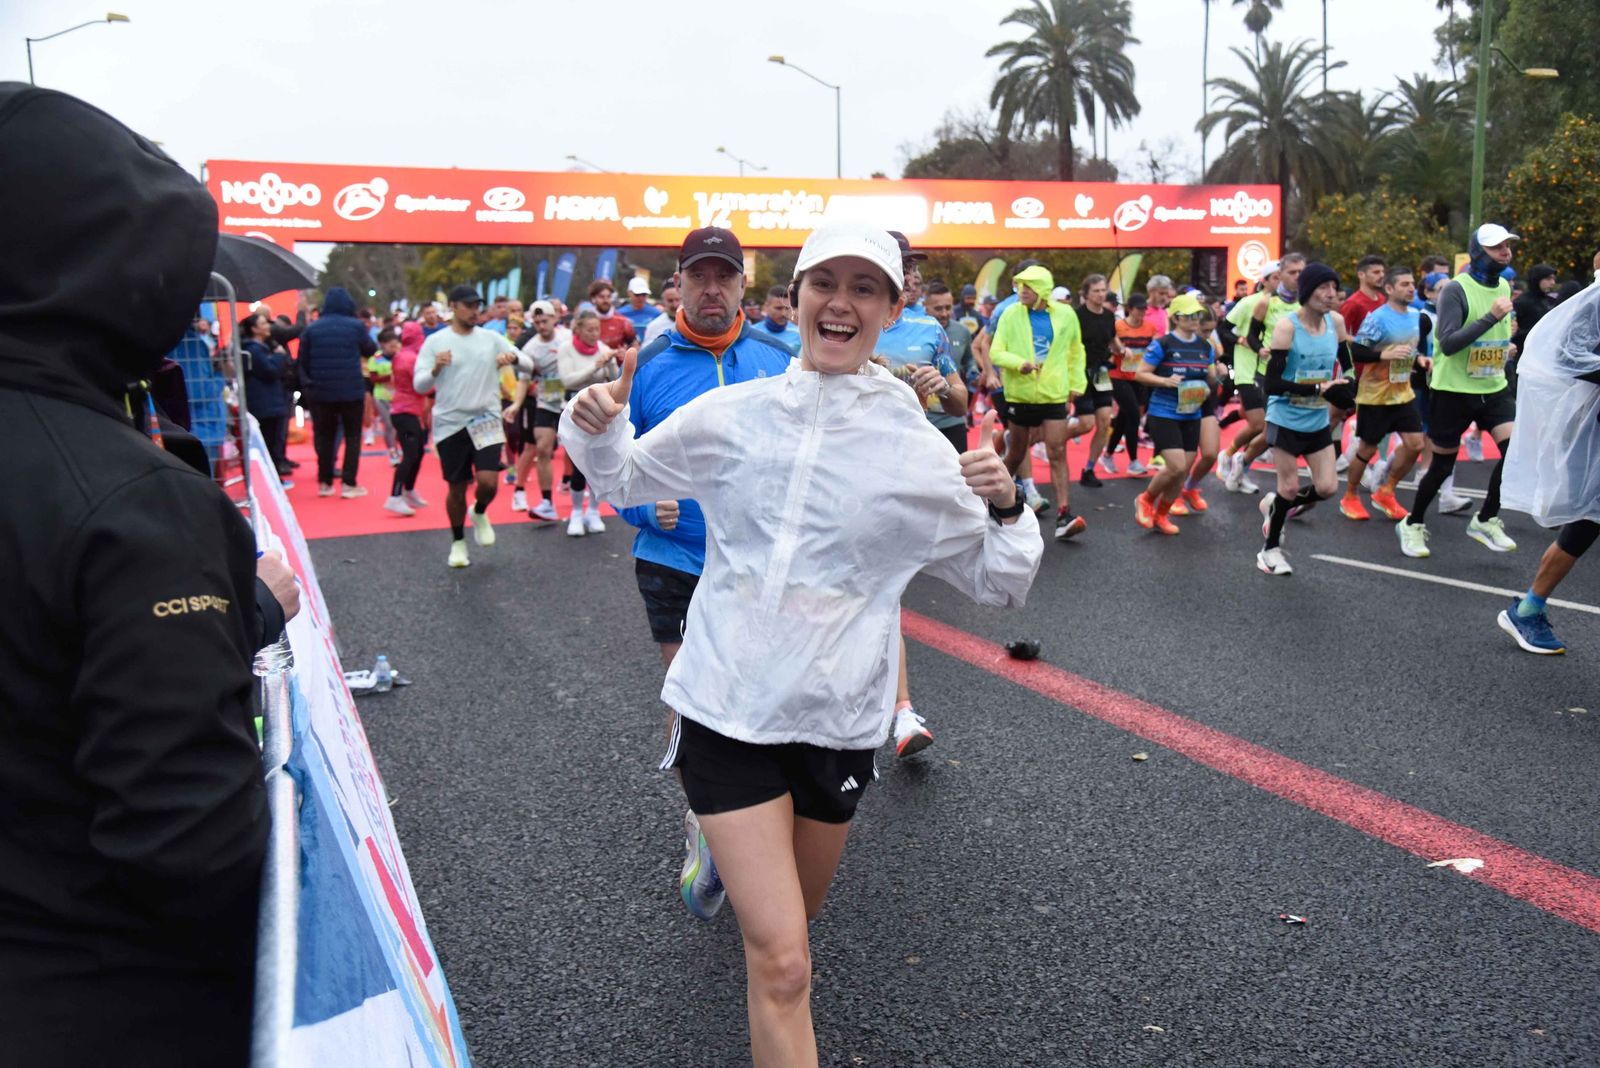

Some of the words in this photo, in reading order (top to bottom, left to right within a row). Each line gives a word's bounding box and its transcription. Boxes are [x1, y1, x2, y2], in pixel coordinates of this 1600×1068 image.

[1474, 348, 1504, 362] 16313
[153, 597, 189, 617] CCI
[189, 594, 230, 615] SPORT
